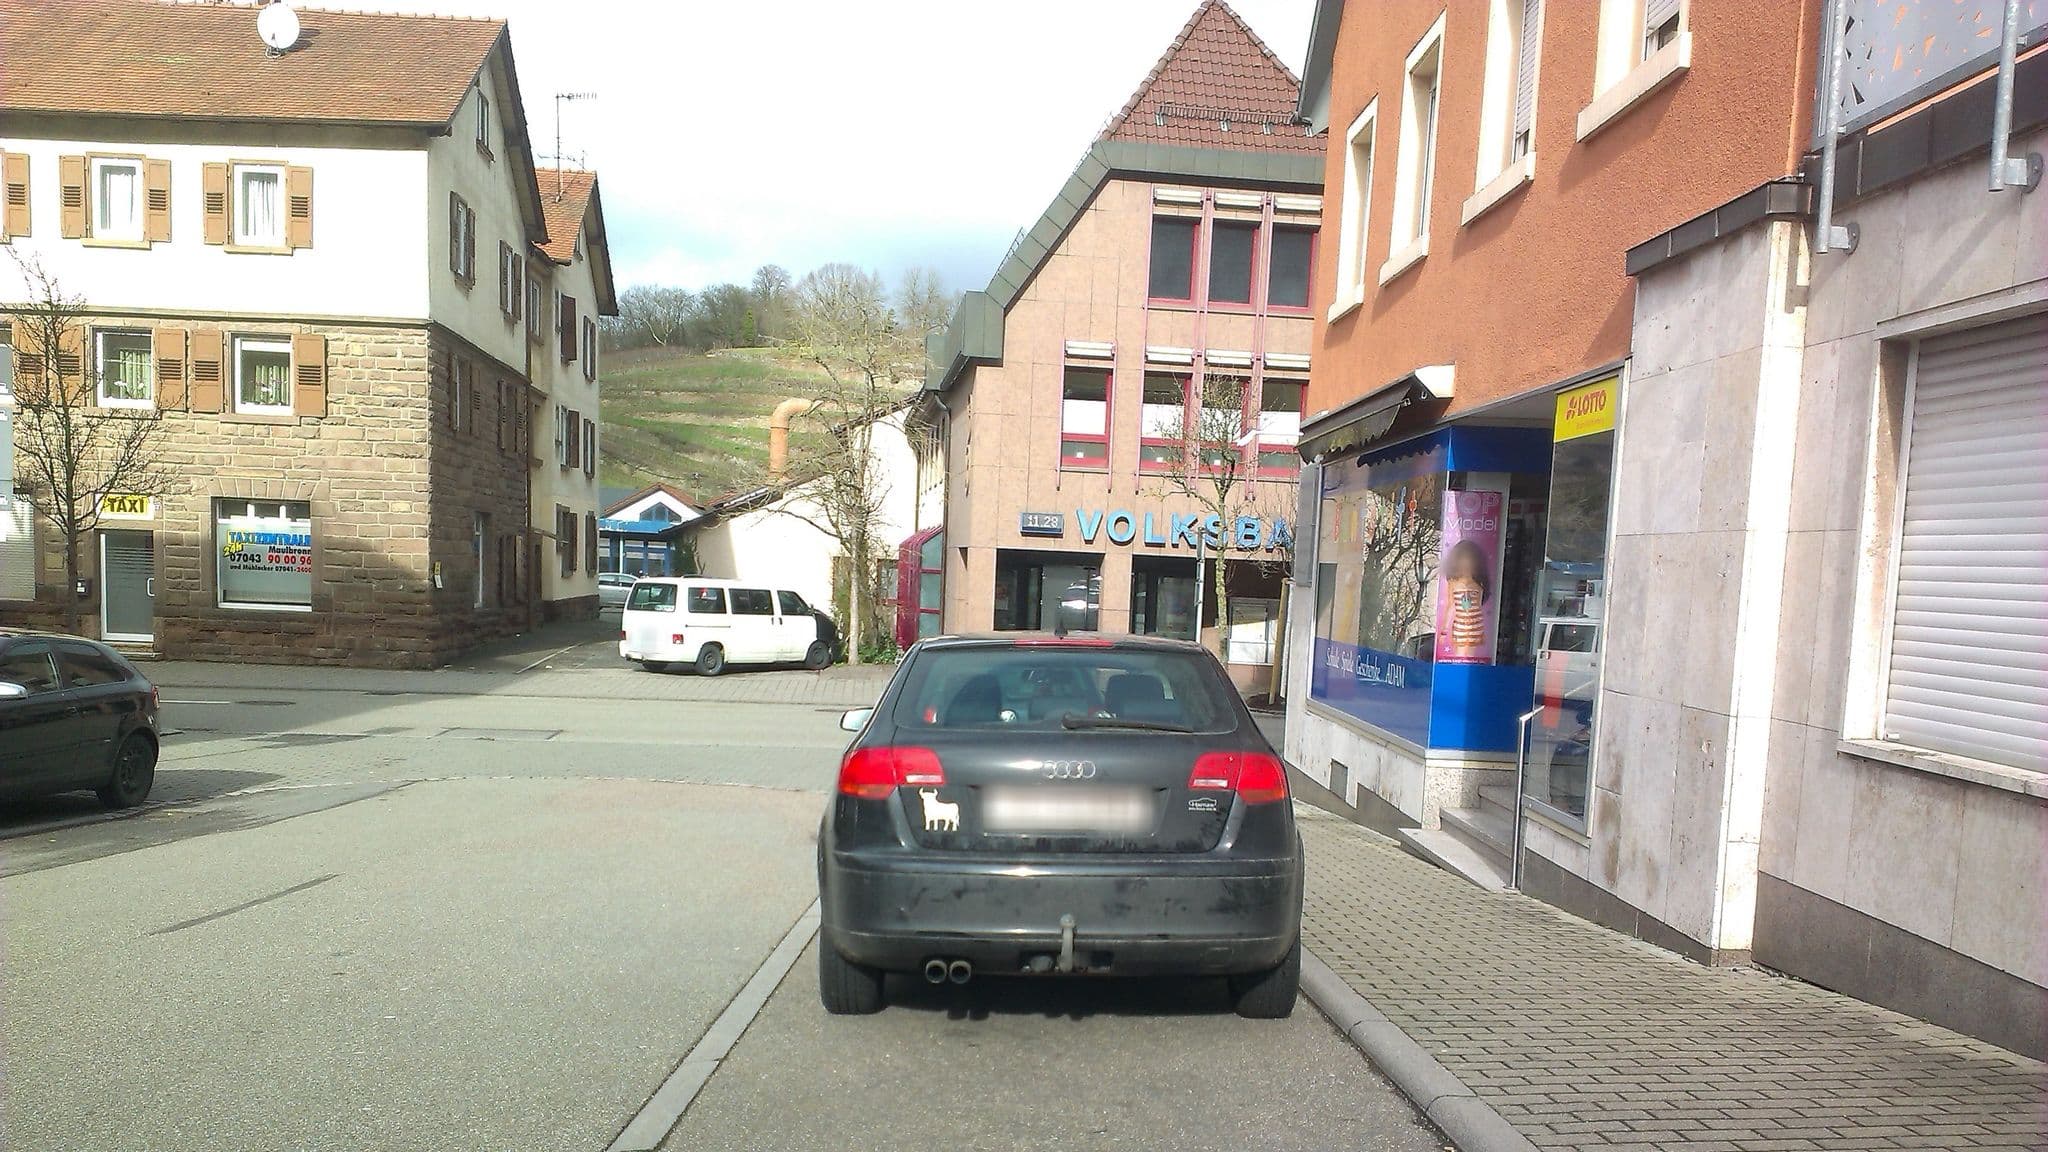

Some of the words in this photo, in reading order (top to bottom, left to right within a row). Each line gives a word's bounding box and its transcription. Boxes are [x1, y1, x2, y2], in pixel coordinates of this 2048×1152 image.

[1577, 389, 1607, 417] LOTTO
[107, 496, 145, 513] TAXI
[1076, 508, 1295, 550] VOLKSBA
[1446, 516, 1497, 531] Model
[222, 542, 244, 557] 24h
[229, 553, 261, 563] 07043
[267, 555, 280, 564] 90
[284, 555, 297, 565] 00
[299, 556, 312, 565] 96
